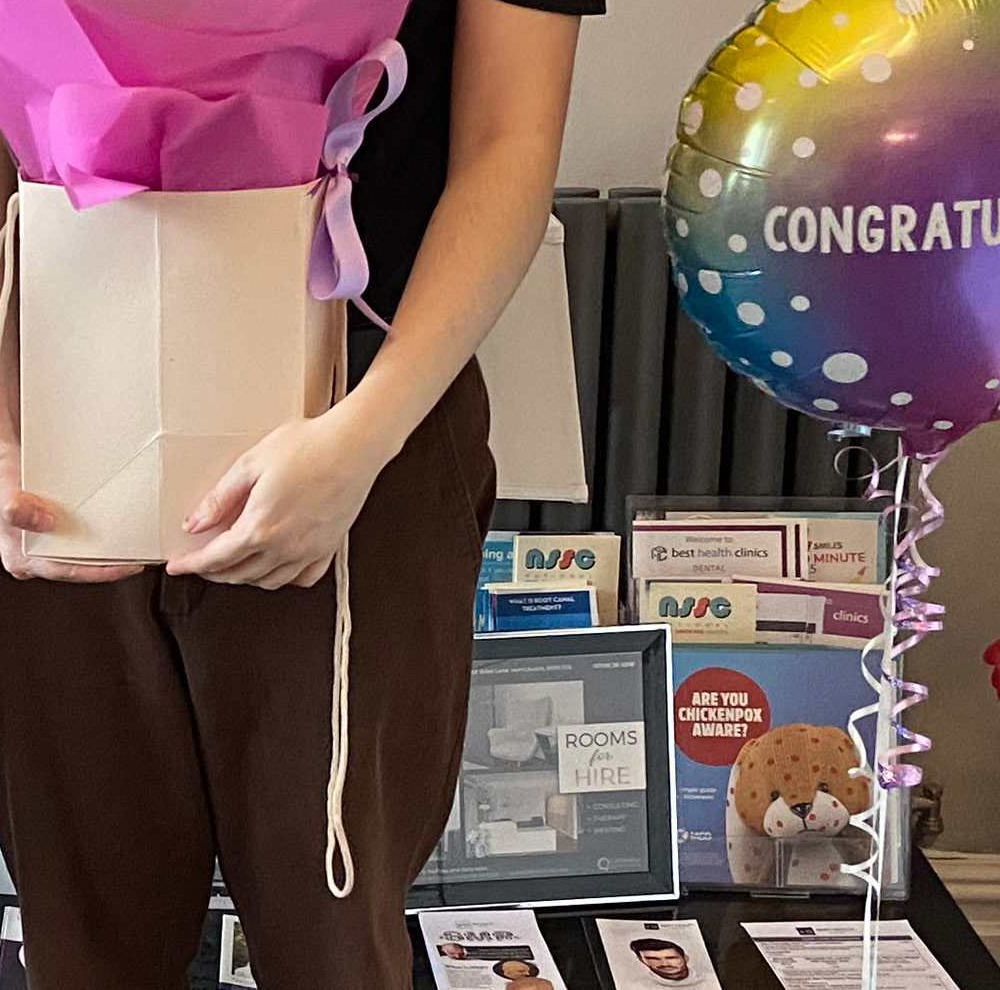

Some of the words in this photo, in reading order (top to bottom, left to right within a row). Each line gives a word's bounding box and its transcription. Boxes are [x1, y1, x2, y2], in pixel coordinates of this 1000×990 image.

[482, 548, 503, 562] ing
[671, 548, 695, 558] best
[697, 548, 732, 558] health
[734, 548, 768, 558] clinics
[814, 552, 866, 563] MINUTE
[693, 564, 726, 572] DENTAL
[833, 610, 868, 623] clinics
[691, 692, 719, 706] ARE
[719, 692, 748, 706] YOU
[678, 707, 762, 722] CHICKENPOX
[692, 723, 748, 737] AWARE?
[566, 731, 637, 748] ROOMS
[590, 749, 613, 766] for
[575, 767, 631, 787] HIRE
